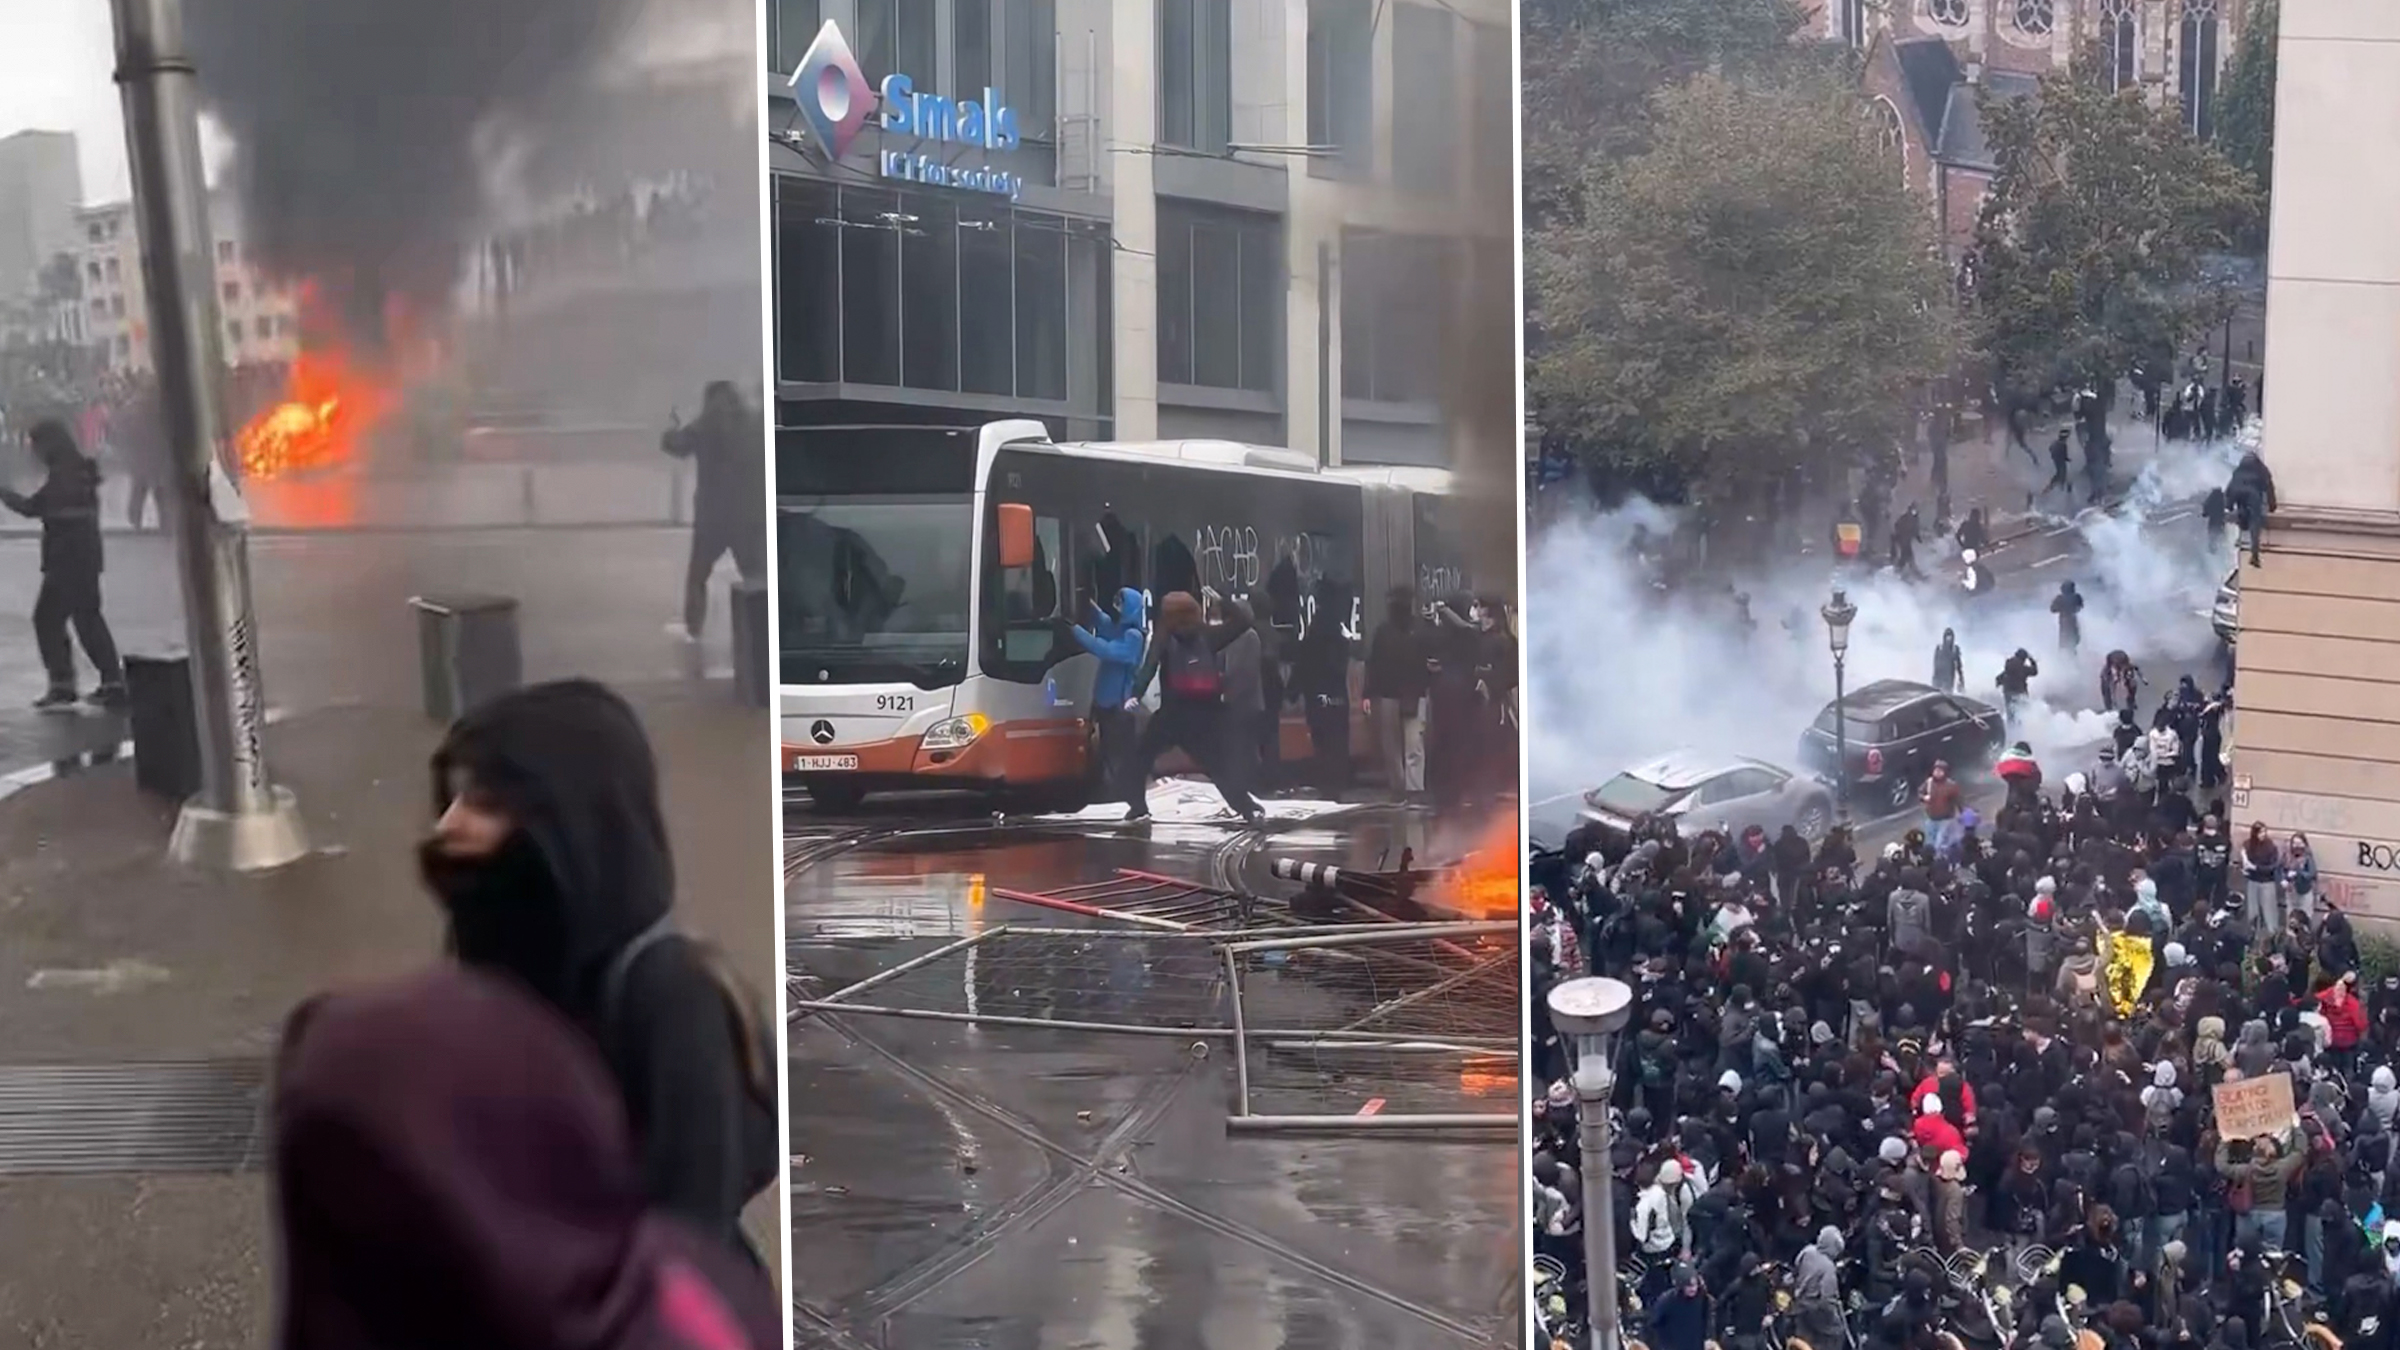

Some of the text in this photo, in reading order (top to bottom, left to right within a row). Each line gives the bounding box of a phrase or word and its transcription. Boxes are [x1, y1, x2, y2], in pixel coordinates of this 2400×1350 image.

[880, 73, 1021, 151] Smals
[1201, 525, 1260, 588] ACAB
[876, 695, 914, 712] 9121
[800, 756, 857, 769] 1-HJJ-483
